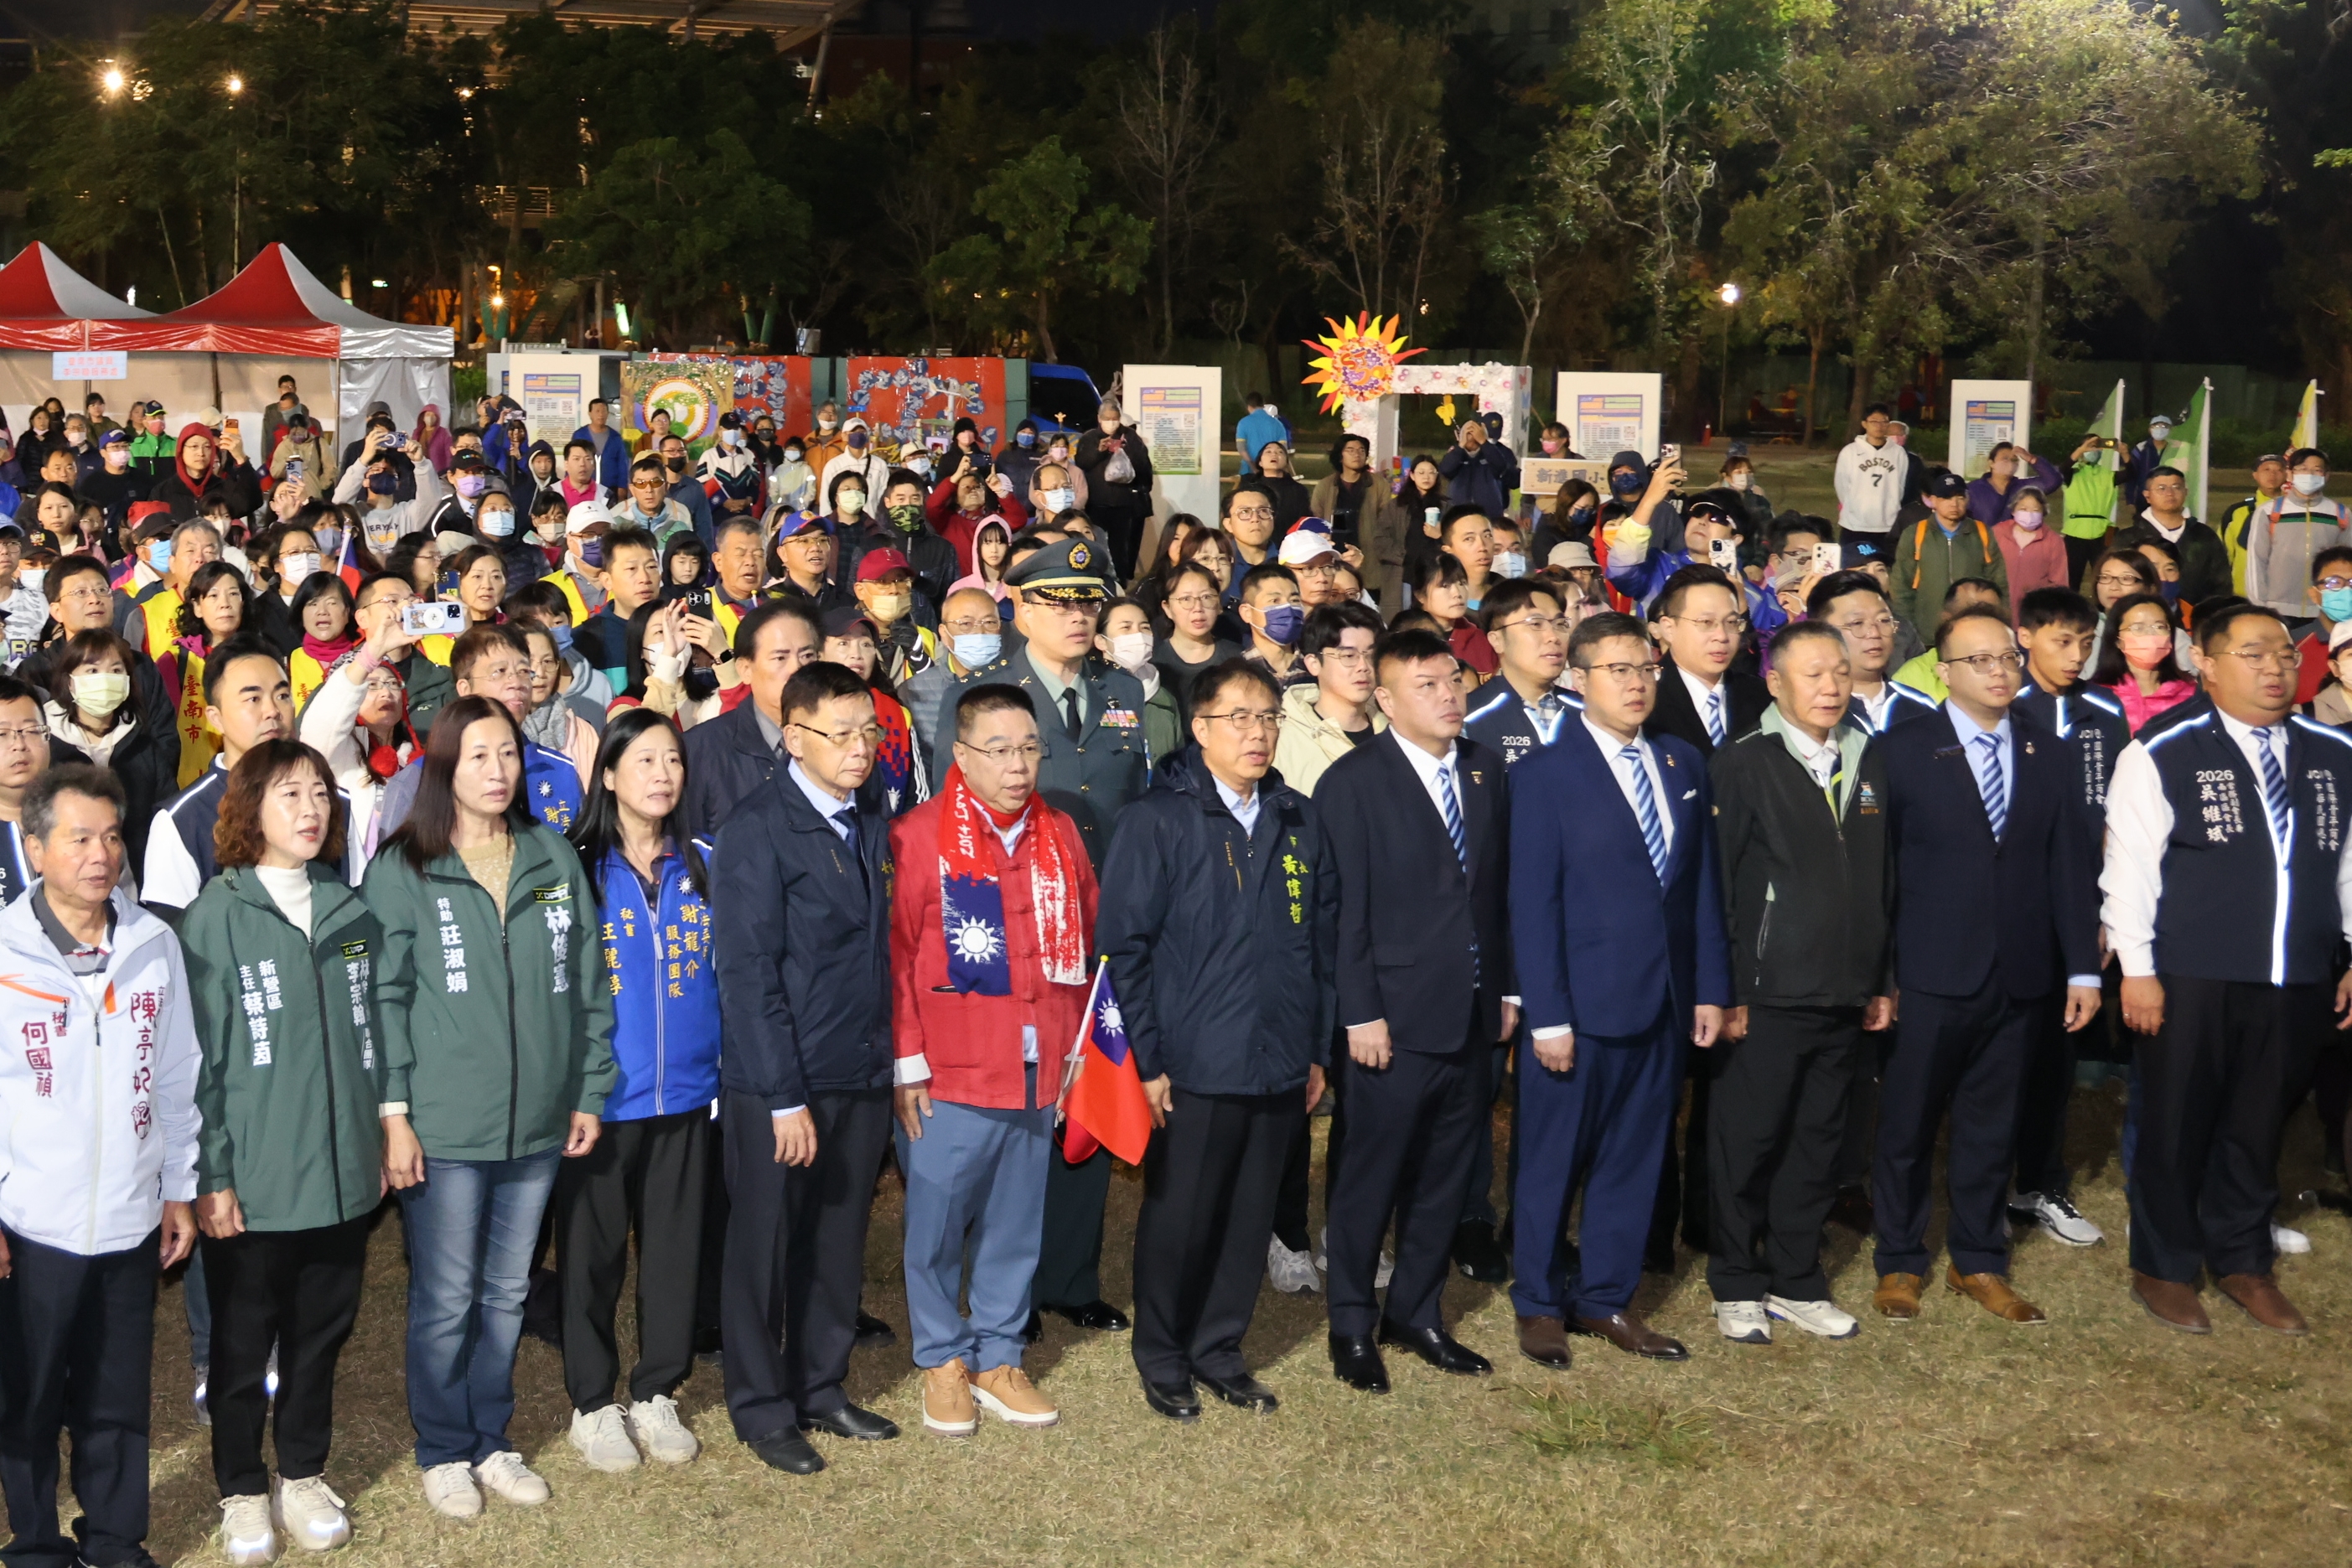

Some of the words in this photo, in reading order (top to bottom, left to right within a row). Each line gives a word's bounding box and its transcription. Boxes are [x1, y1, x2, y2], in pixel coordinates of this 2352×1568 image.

[1858, 457, 1896, 474] BOSTON
[1871, 474, 1883, 488] 7
[184, 675, 203, 744] 臺南市
[1501, 735, 1531, 746] 2026
[1505, 748, 1520, 772] 吳
[2195, 769, 2235, 783] 2026
[558, 799, 571, 834] 立法
[437, 897, 454, 923] 特助
[1282, 854, 1303, 924] 黃偉哲
[544, 905, 572, 994] 林俊憲
[619, 907, 635, 938] 秘書
[680, 903, 701, 980] 謝龍介
[239, 964, 256, 991] 主任
[258, 958, 284, 1011] 新營區
[439, 924, 469, 993] 莊淑娟
[666, 924, 685, 999] 服務團隊
[346, 961, 366, 1027] 李宗翰
[131, 989, 158, 1095] 陳亭妃
[241, 991, 272, 1067] 蔡詩茵
[22, 1021, 54, 1099] 何國禎
